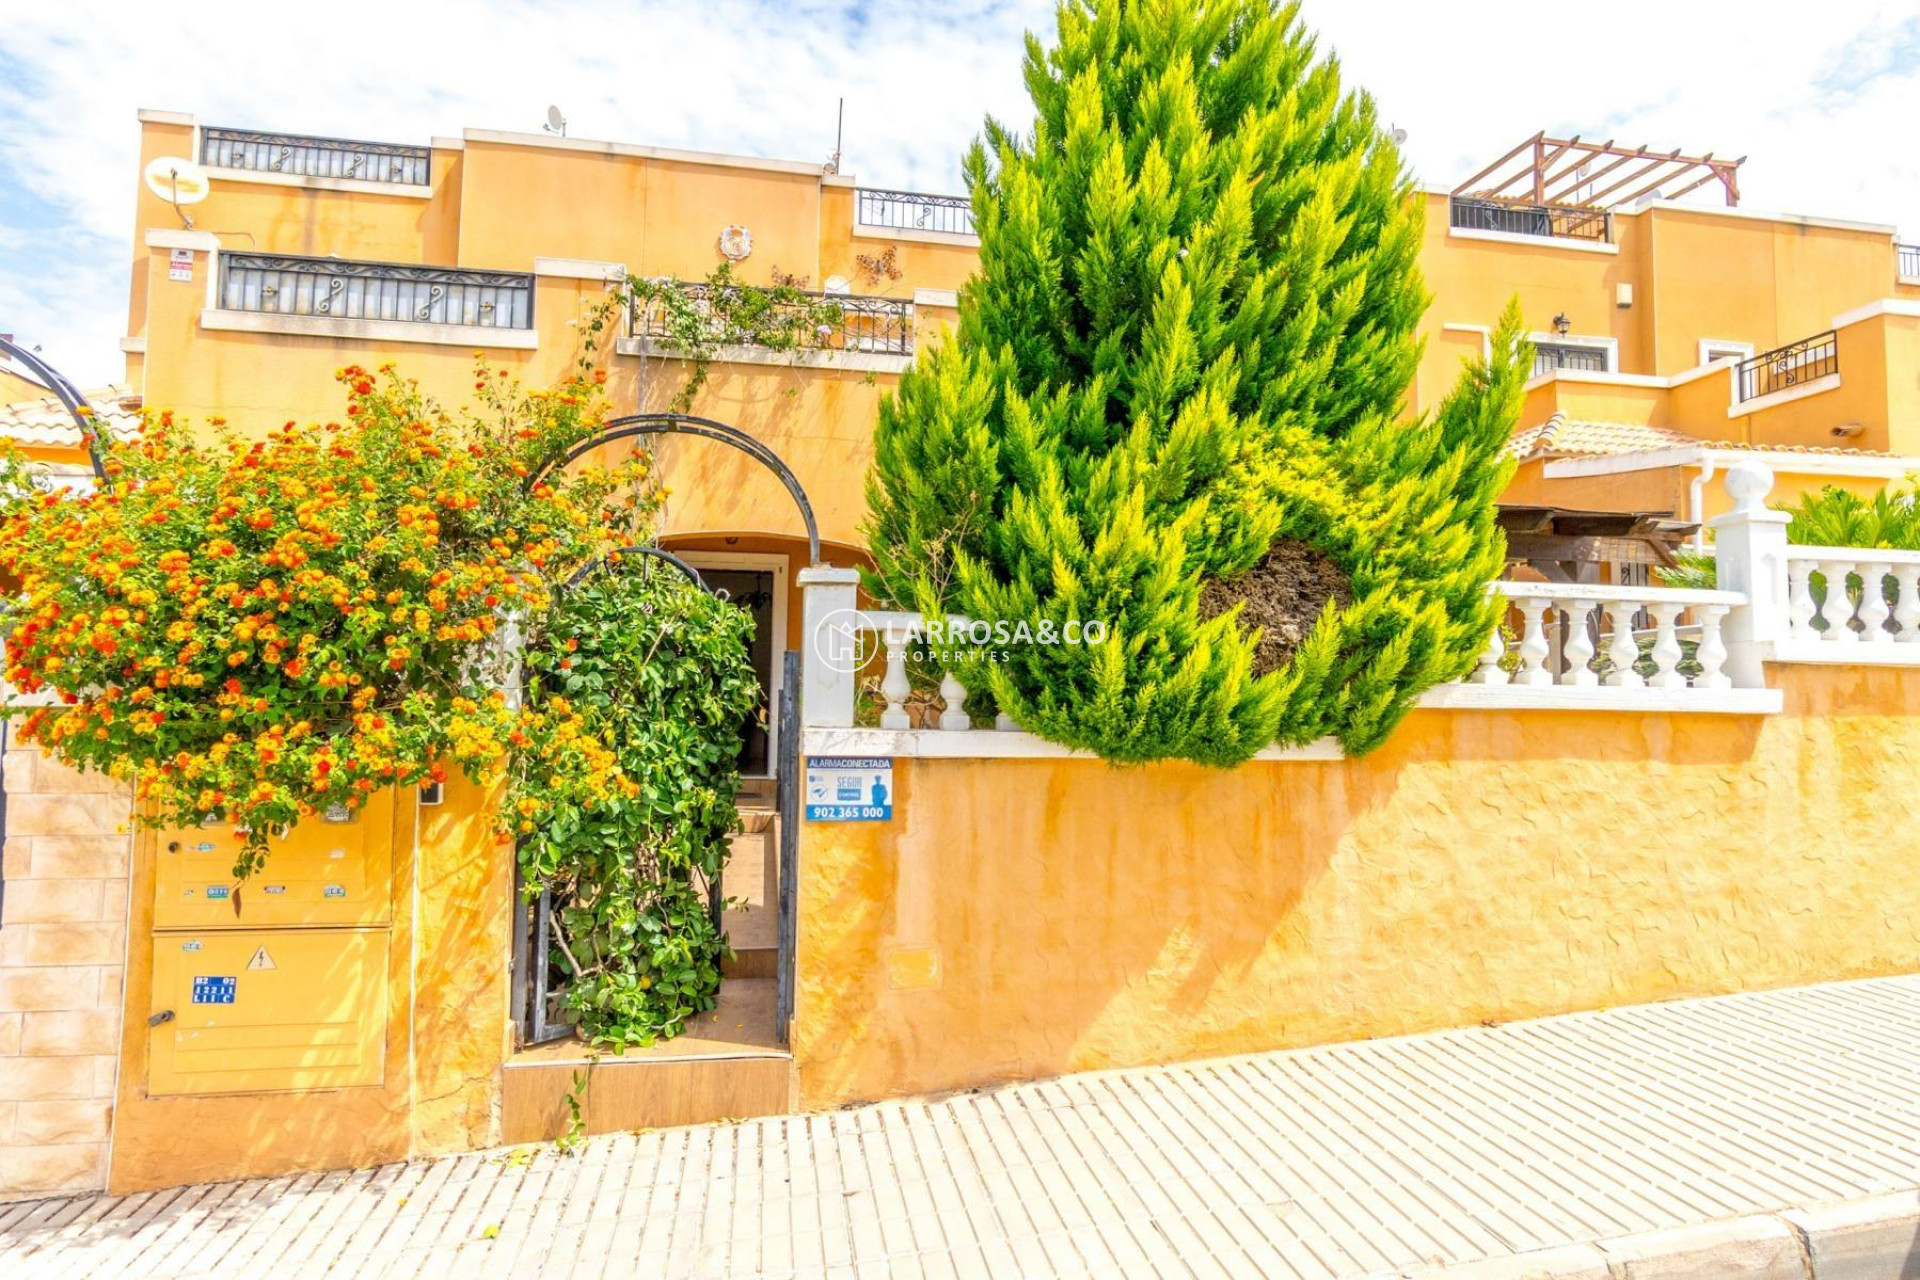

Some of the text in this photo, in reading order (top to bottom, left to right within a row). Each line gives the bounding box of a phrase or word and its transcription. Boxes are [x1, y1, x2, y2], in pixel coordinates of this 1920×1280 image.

[837, 776, 862, 788] SEGUR
[813, 807, 884, 818] 902 365 000
